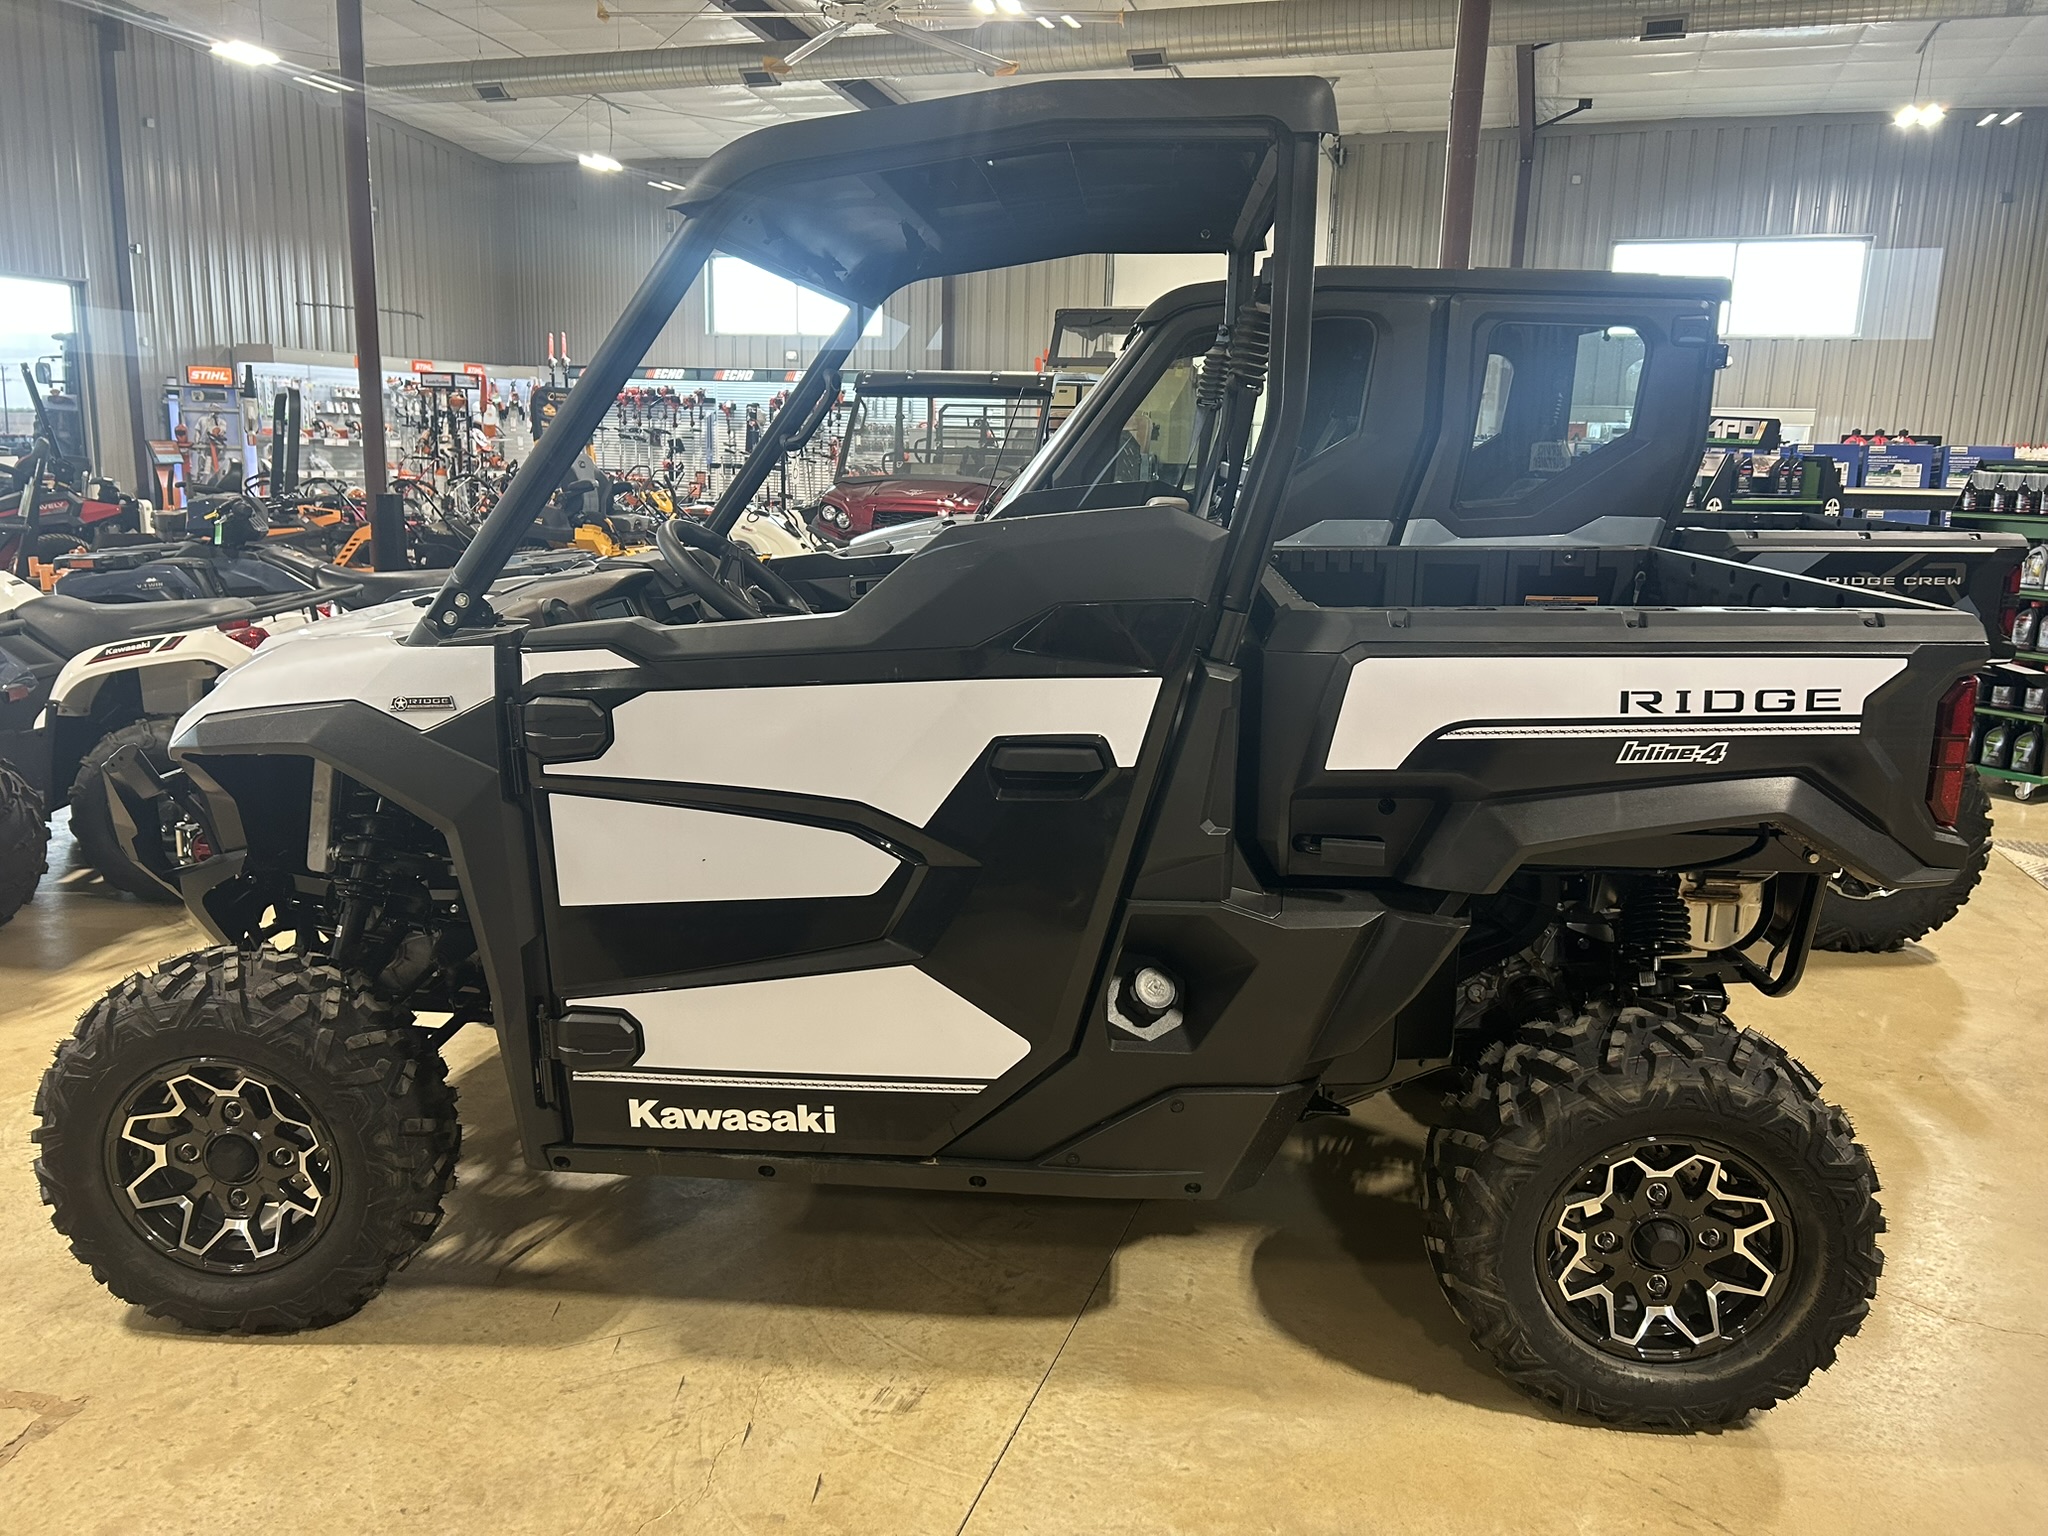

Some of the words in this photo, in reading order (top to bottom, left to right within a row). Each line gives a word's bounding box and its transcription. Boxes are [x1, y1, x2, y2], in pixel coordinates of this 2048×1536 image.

[190, 369, 229, 381] STIHL
[652, 367, 686, 380] ECHO
[721, 369, 755, 381] ECHO
[1826, 576, 1896, 586] RIDGE
[1903, 576, 1962, 586] CREW
[105, 640, 151, 656] Kawasaki
[409, 697, 450, 705] RIDGE
[1619, 688, 1842, 714] RIDGE
[1615, 740, 1730, 765] Inline-4
[628, 1098, 836, 1134] Kawasaki
